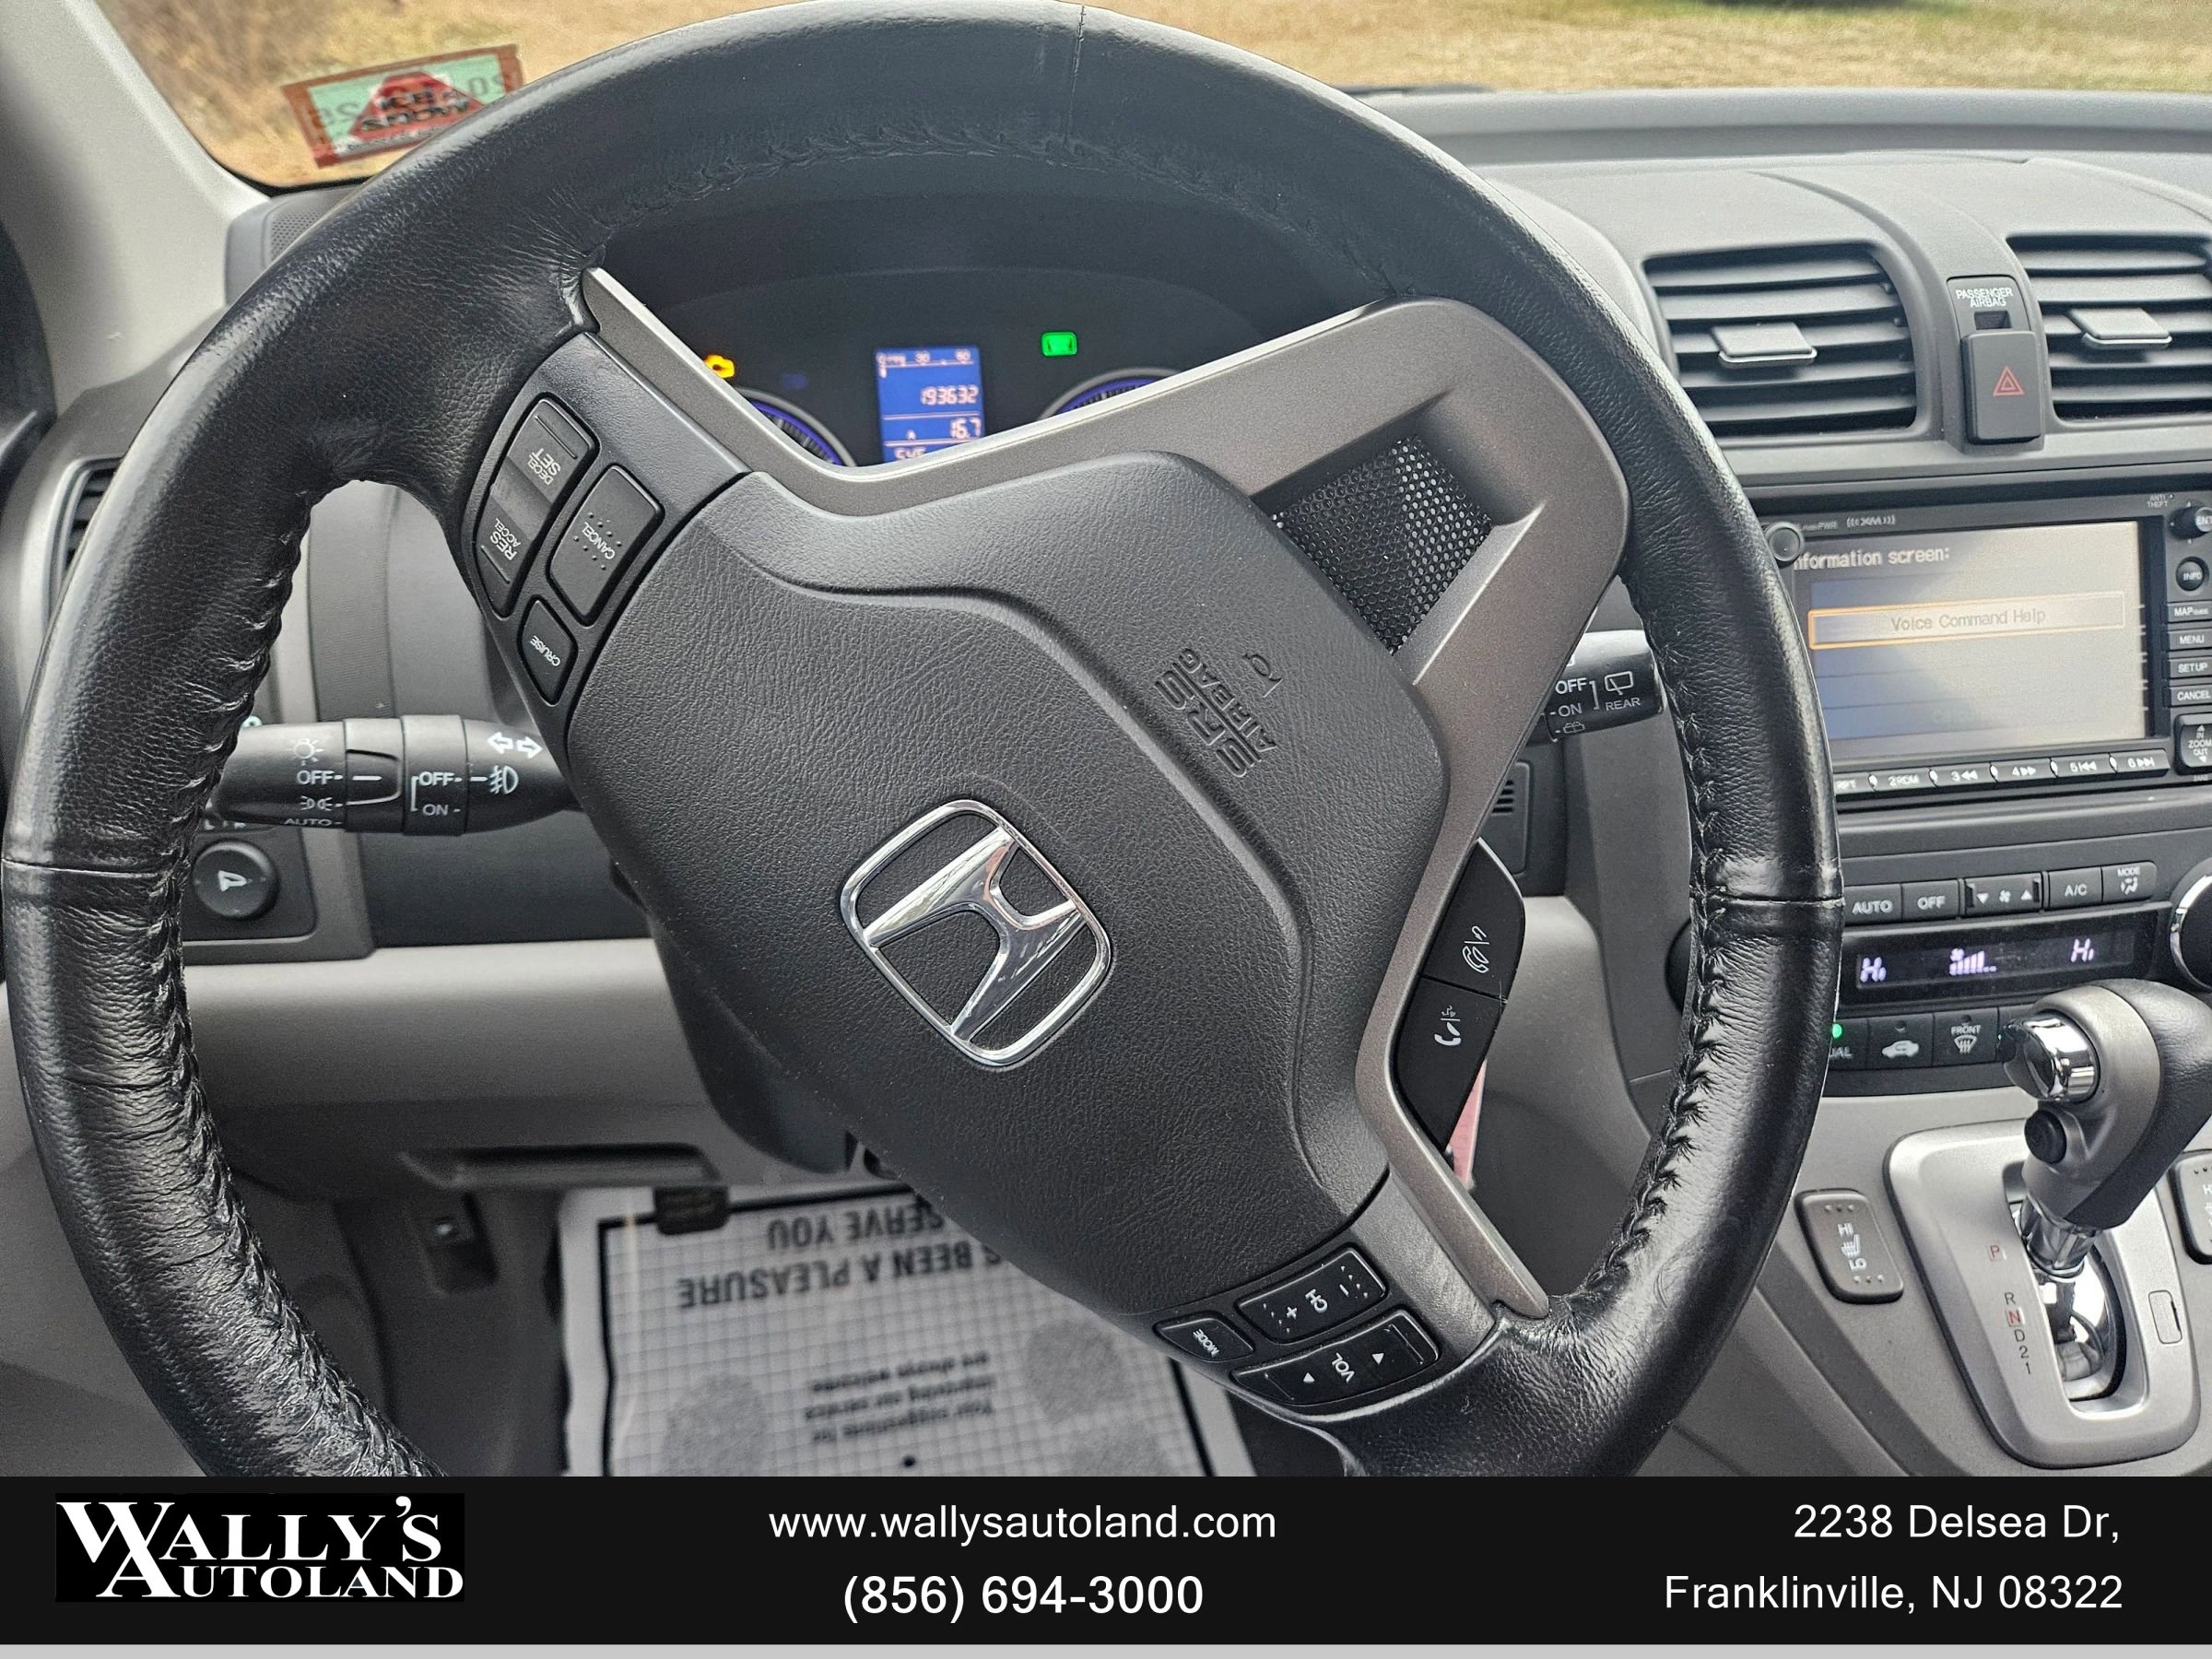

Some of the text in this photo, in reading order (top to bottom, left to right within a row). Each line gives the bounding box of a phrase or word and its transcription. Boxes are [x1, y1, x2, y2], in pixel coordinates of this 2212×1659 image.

[1955, 287, 2014, 300] PASSENGER
[1970, 297, 2007, 309] AIRBAG
[920, 384, 979, 406] 193632
[532, 448, 561, 477] SET
[527, 454, 554, 487] DECEL
[495, 517, 521, 547] ACCEL
[489, 530, 518, 560] RES
[582, 522, 616, 559] CANCEL
[1794, 547, 1950, 571] nformation screen:
[2183, 571, 2203, 582] INFO
[1891, 607, 2046, 631] Voice Command Help
[2173, 606, 2194, 617] MAP
[2179, 634, 2205, 645] MENU
[530, 635, 561, 666] CRUISE
[2177, 663, 2208, 674] SETUP
[1555, 677, 1587, 695] OFF
[1178, 649, 1277, 753] AIRBAG
[2176, 690, 2211, 701] CANCEL
[1558, 703, 1583, 718] ON
[1605, 697, 1641, 712] REAR
[1155, 669, 1254, 778] SRS
[2187, 739, 2212, 749] ZOOM
[2193, 747, 2208, 757] OUT
[296, 771, 335, 785] OFF
[418, 771, 453, 786] OFF
[422, 804, 449, 817] ON
[284, 818, 333, 827] AUTO
[2116, 866, 2140, 877] MODE
[2064, 882, 2088, 898] A/C
[1852, 899, 1893, 914] AUTO
[1917, 895, 1947, 911] OFF
[1951, 1023, 1982, 1037] FRONT
[767, 1205, 946, 1253] SERVE YOU
[1837, 1222, 1854, 1238] HI
[1990, 1244, 2001, 1259] P
[893, 1241, 974, 1279] BEEN
[862, 1252, 882, 1285] A
[677, 1258, 851, 1310] PLEASURE
[1305, 1288, 1328, 1314] CH
[2004, 1291, 2016, 1306] R
[2008, 1309, 2021, 1324] N
[1193, 1328, 1219, 1357] MODE
[2014, 1328, 2026, 1343] D
[2018, 1345, 2030, 1359] 2
[1331, 1352, 1356, 1383] VOL
[2025, 1361, 2031, 1375] 1
